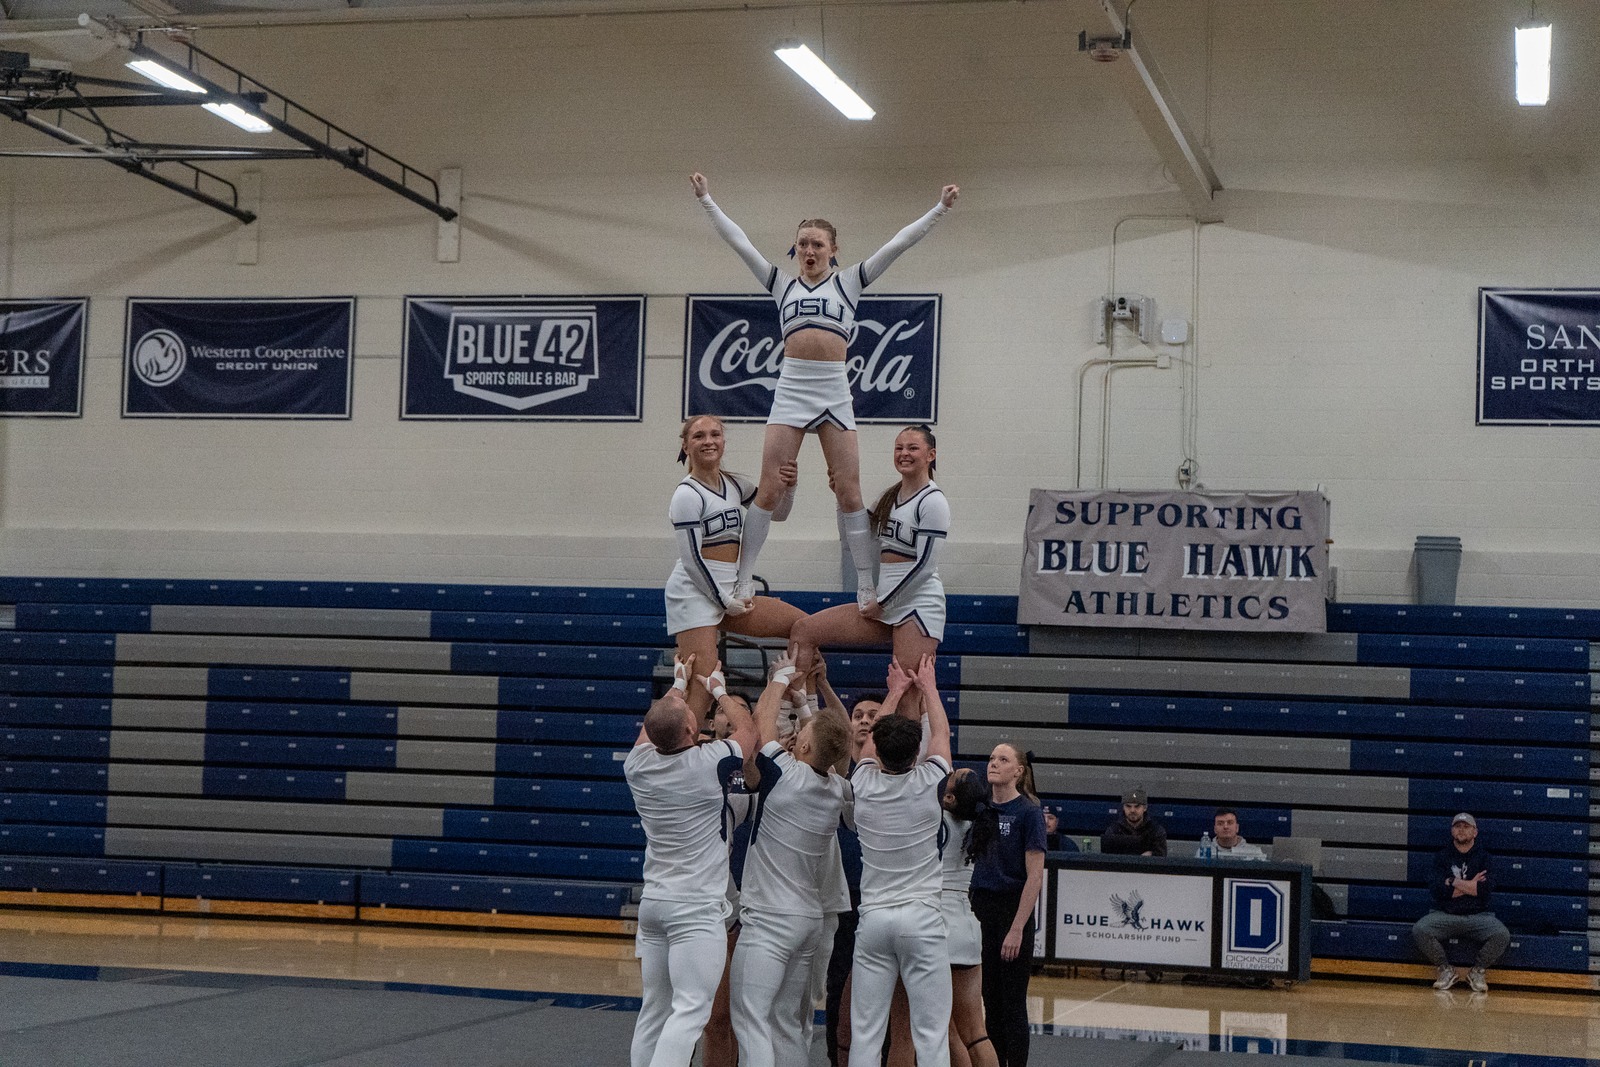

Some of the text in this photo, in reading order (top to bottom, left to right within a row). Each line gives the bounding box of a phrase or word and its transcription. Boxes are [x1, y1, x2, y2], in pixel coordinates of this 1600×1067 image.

[456, 324, 585, 365] BLUE 42
[190, 345, 345, 361] Western Cooperative
[215, 362, 319, 371] CREDIT UNION
[1520, 359, 1595, 373] ORTH
[465, 371, 577, 386] SPORTS GRILLE & BAR
[1491, 376, 1600, 391] SPORTS
[1055, 500, 1304, 531] SUPPORTING
[1038, 538, 1318, 582] BLUE HAWK
[1062, 590, 1291, 620] ATHLETICS
[1063, 913, 1206, 932] BLUE HAWK
[1086, 931, 1181, 943] SCHOLARSHIP FUND
[1225, 954, 1284, 965] DICKINSON
